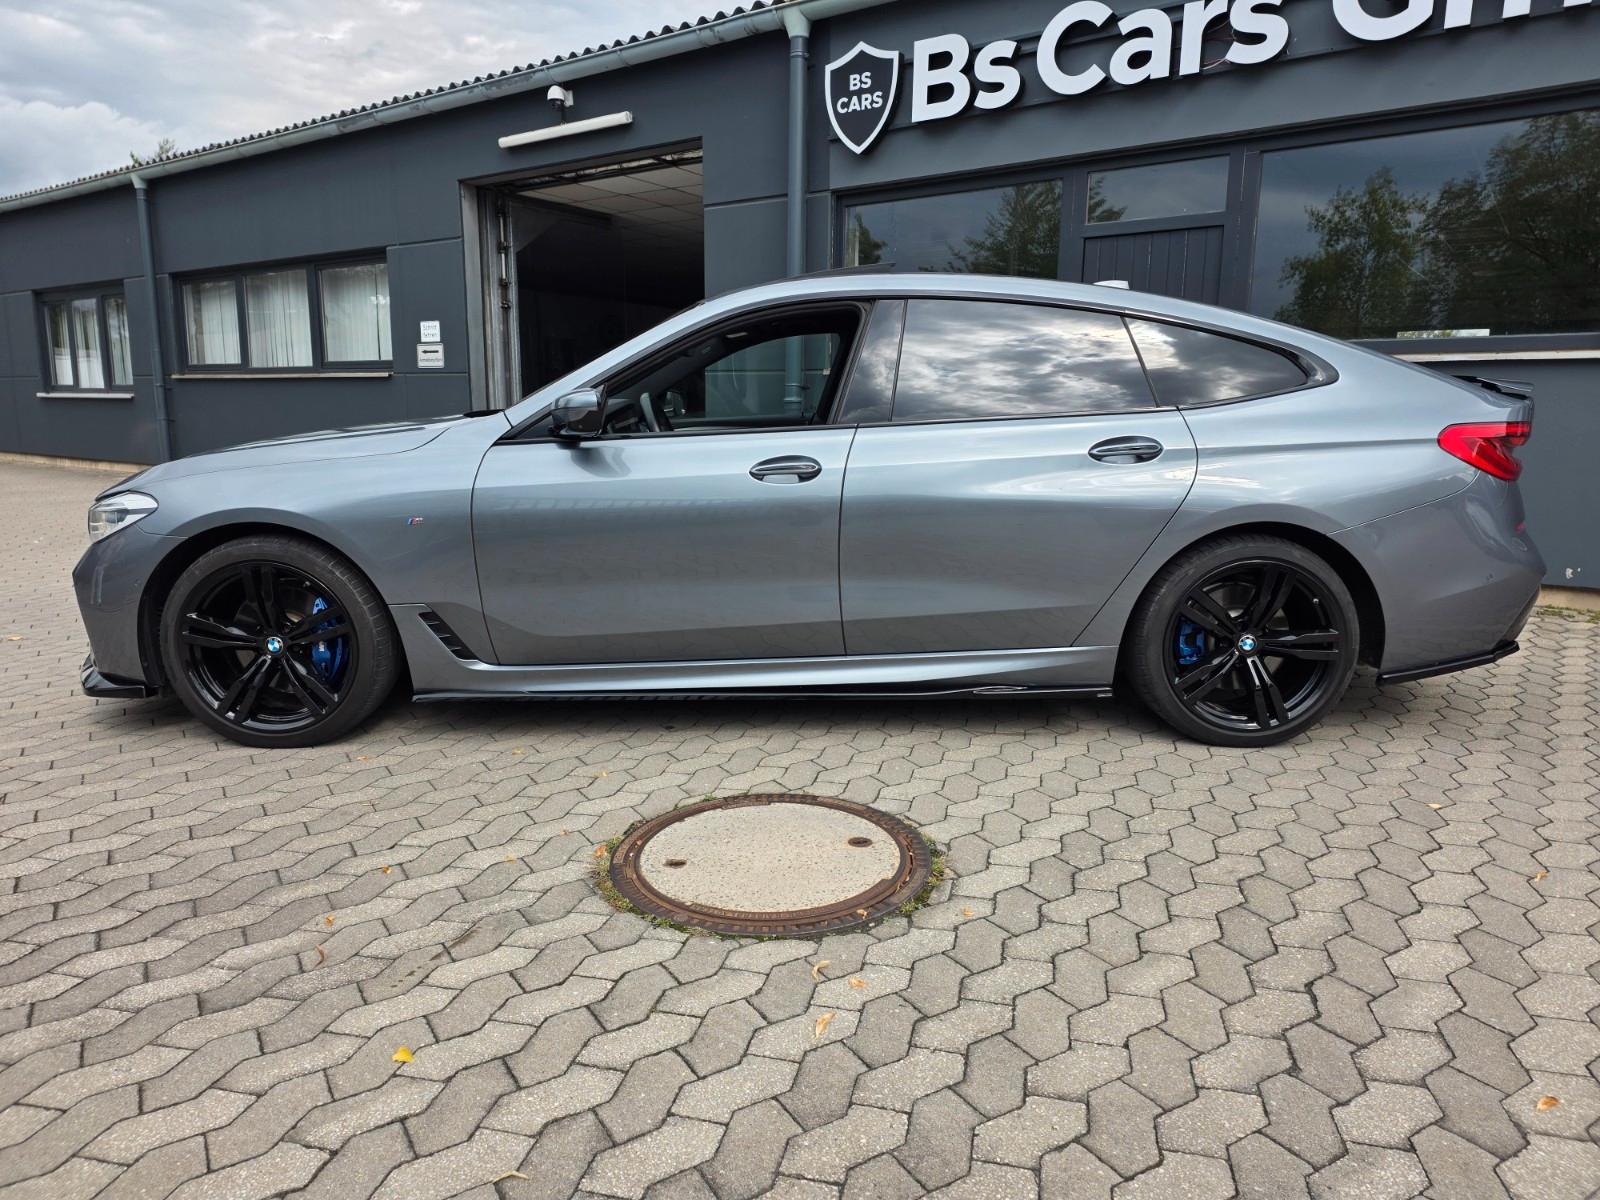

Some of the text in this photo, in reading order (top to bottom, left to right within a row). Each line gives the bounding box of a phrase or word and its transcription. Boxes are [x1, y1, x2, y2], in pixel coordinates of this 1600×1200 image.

[911, 33, 1021, 123] Bs
[1036, 0, 1289, 95] Cars
[849, 71, 872, 91] BS
[836, 91, 884, 114] CARS
